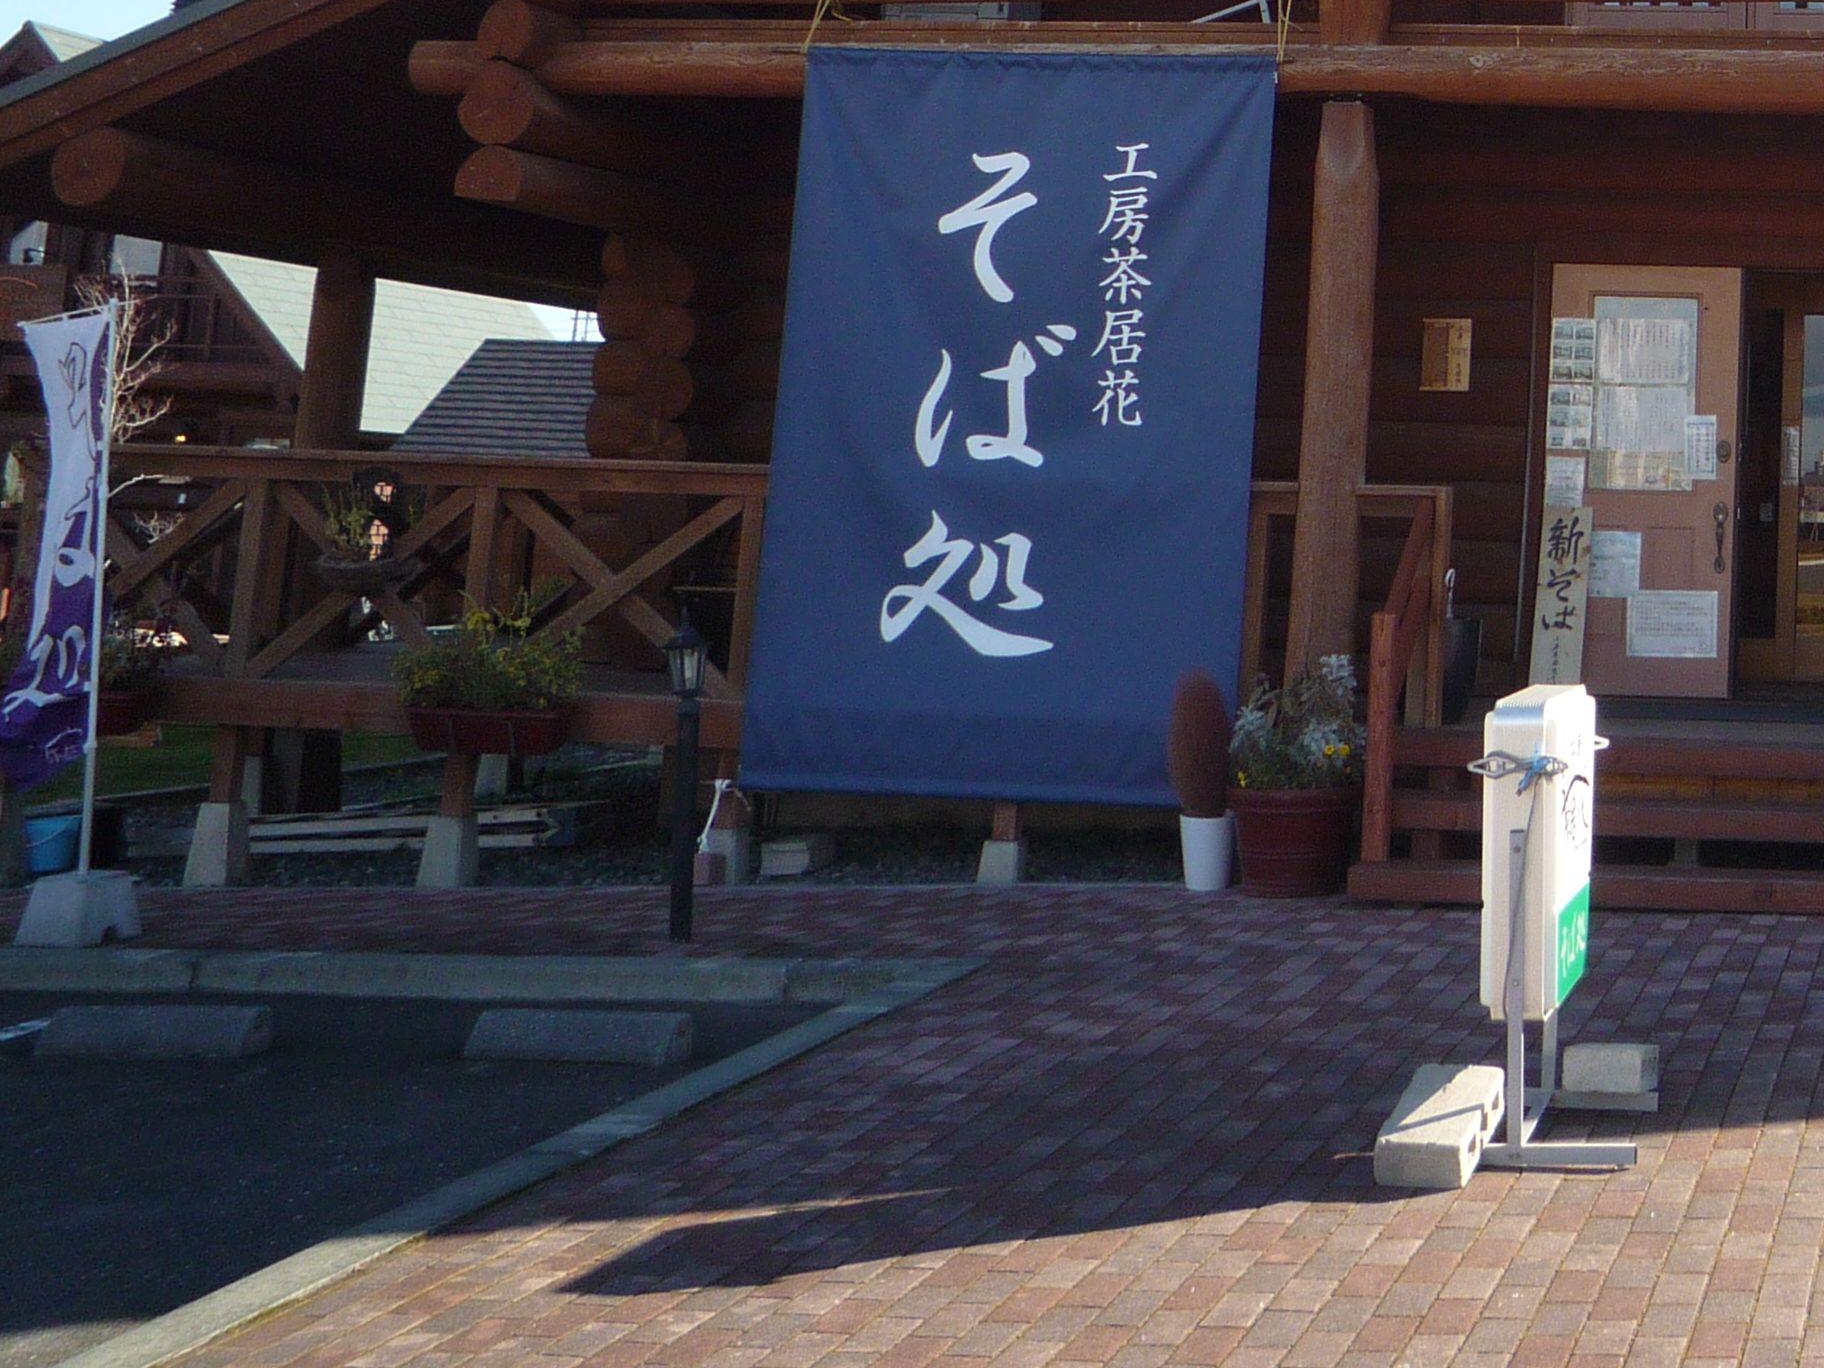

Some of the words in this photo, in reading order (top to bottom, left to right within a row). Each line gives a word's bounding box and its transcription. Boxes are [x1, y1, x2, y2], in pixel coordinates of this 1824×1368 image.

[879, 150, 1078, 658] そば処
[1090, 141, 1158, 428] 工房茶居花
[1541, 514, 1585, 631] 新そば
